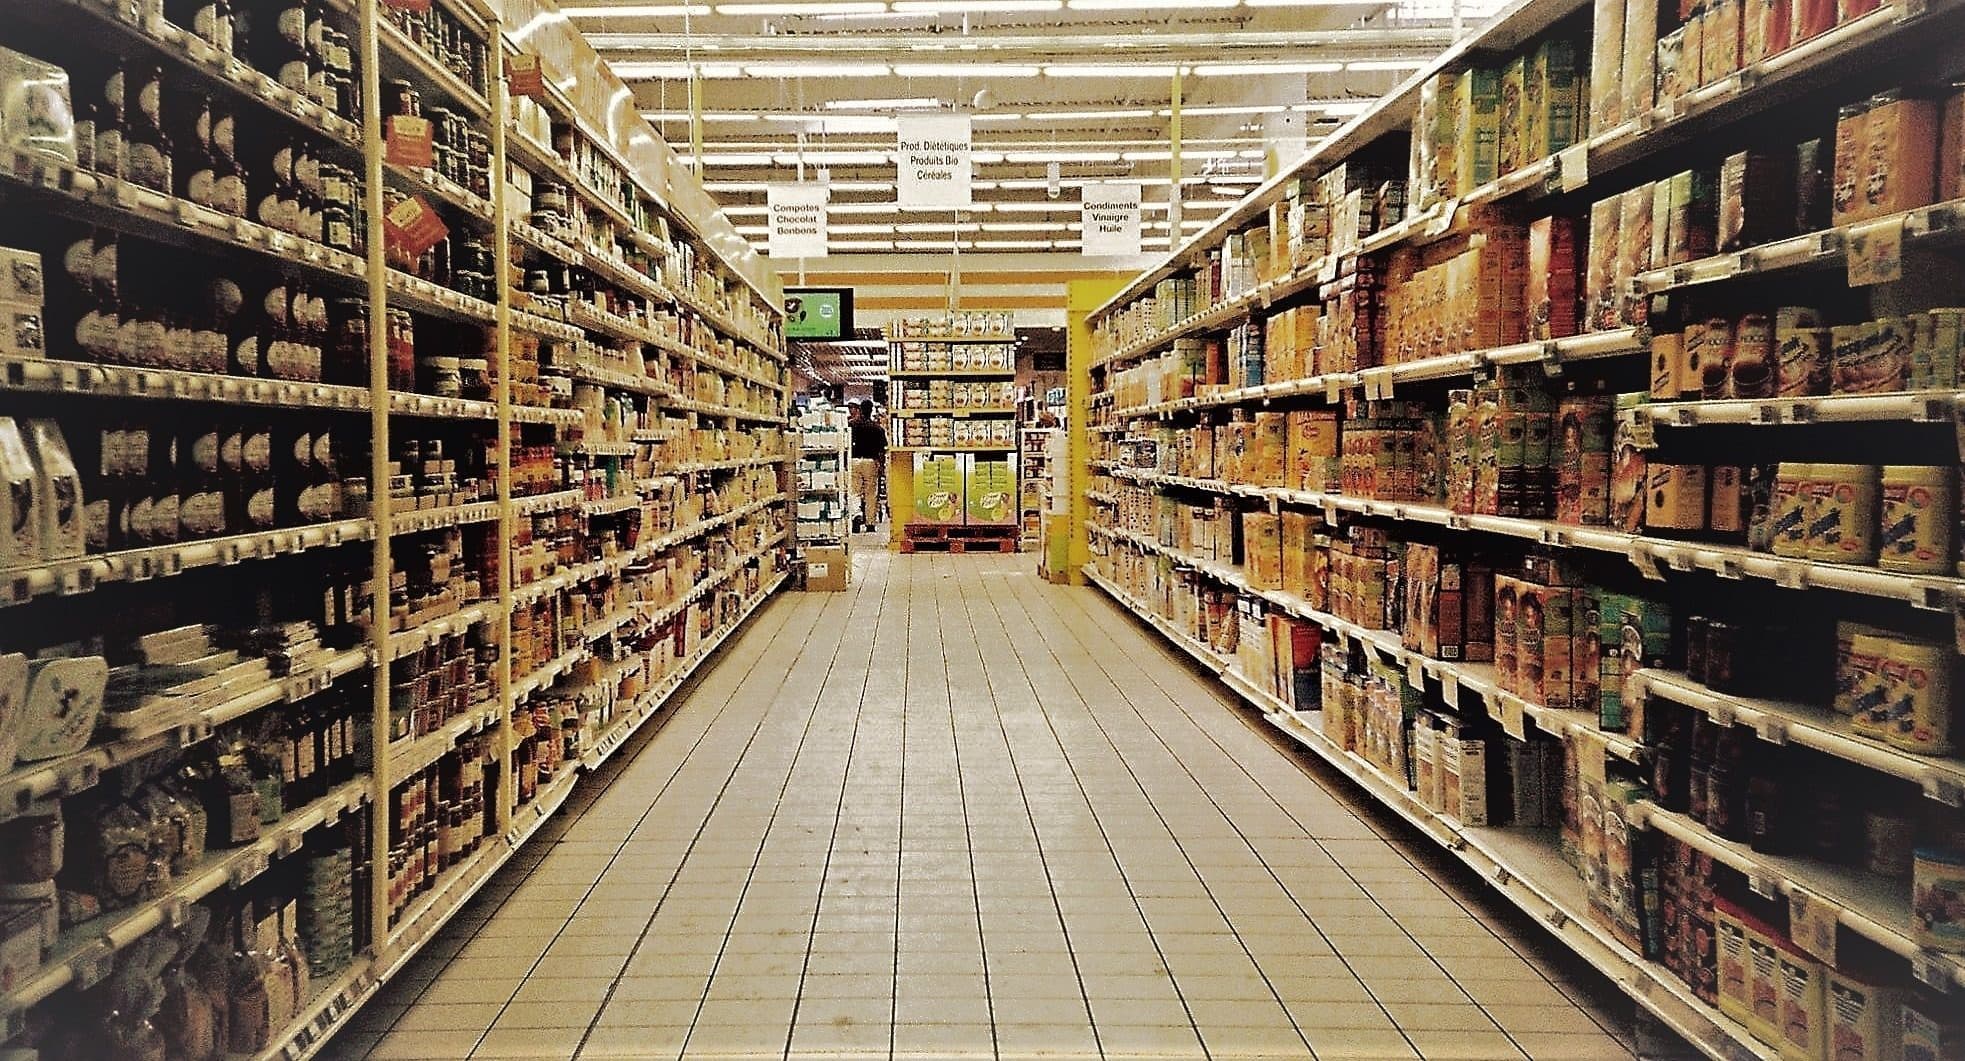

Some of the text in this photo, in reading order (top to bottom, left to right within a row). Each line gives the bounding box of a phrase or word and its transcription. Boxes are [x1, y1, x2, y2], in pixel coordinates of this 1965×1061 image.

[900, 141, 922, 151] Prod.
[910, 155, 959, 166] Produits Bio
[773, 204, 820, 213] Compotes
[1083, 201, 1138, 210] Condiments
[776, 215, 817, 224] Chocolat
[1091, 213, 1129, 223] Vinaigre
[777, 226, 817, 235] Bonbons
[1099, 225, 1122, 233] Huile
